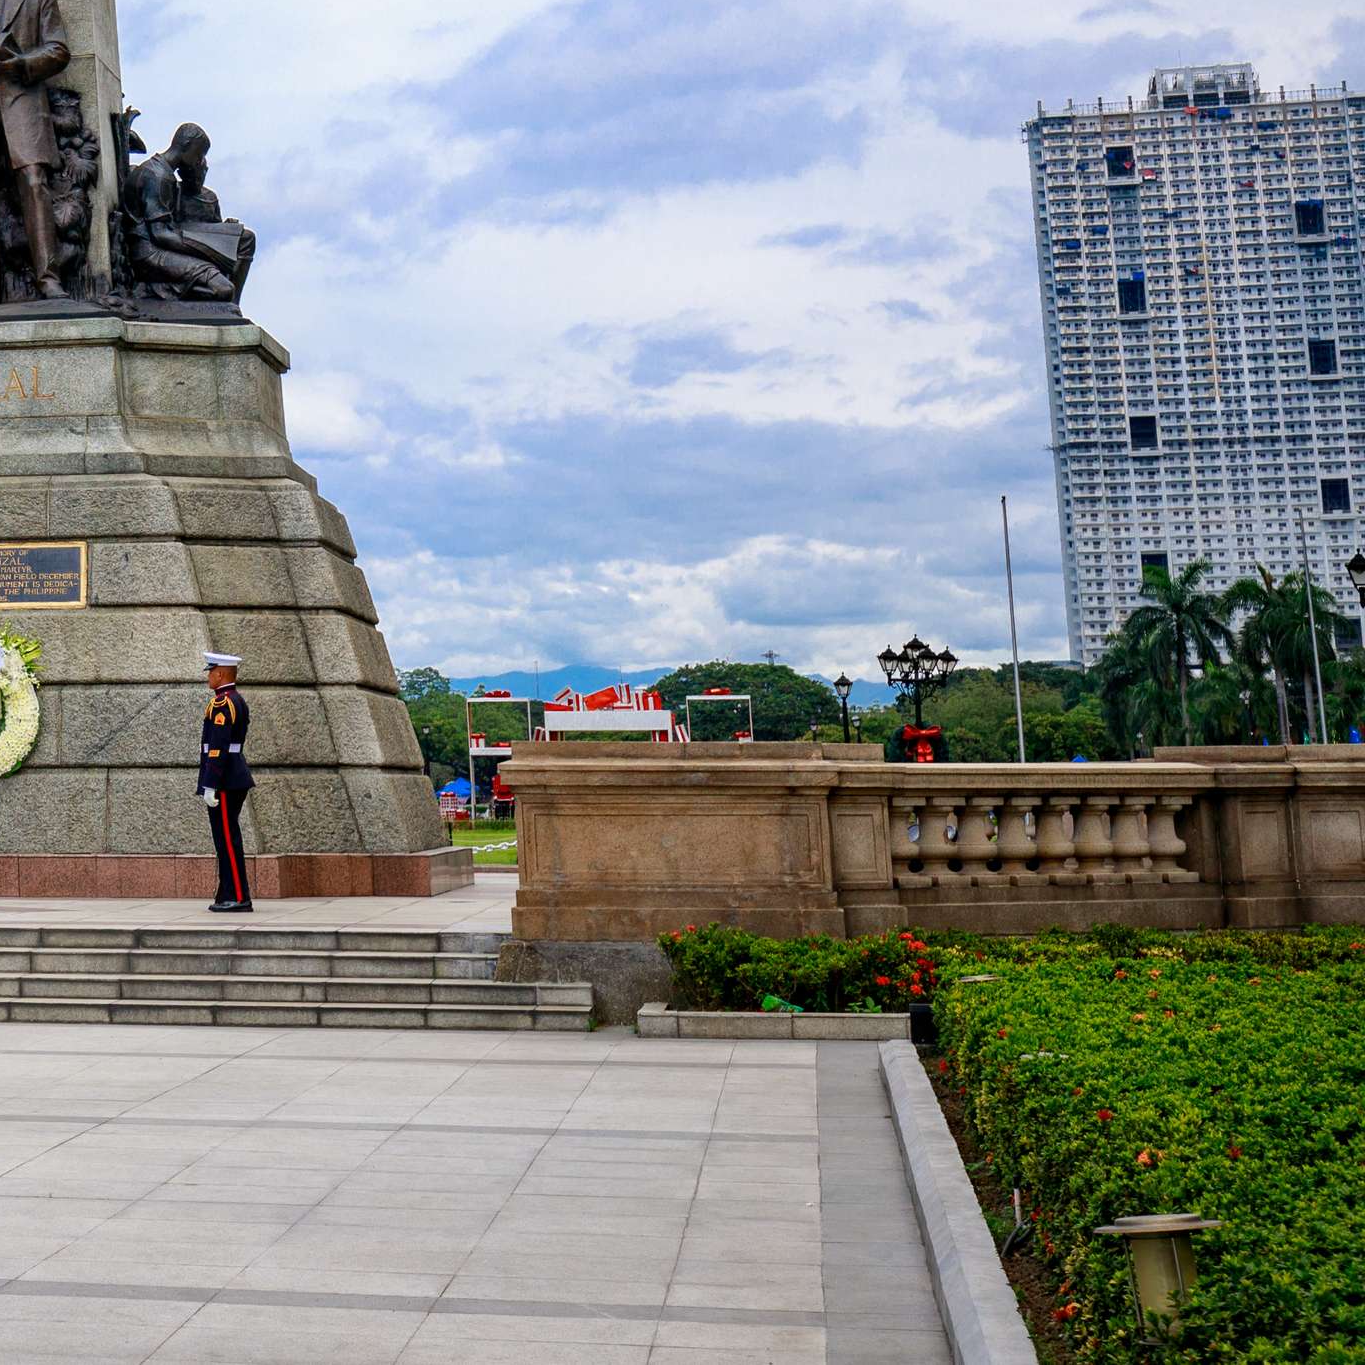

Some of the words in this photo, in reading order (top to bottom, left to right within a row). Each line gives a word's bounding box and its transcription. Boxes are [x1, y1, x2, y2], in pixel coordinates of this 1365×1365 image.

[0, 565, 33, 573] MARTYR
[13, 573, 37, 581] FIELD
[38, 572, 80, 581] DECEMBER
[32, 580, 40, 588] IS
[43, 580, 78, 588] DEDICA-
[4, 588, 20, 596] THE
[23, 587, 68, 595] PHILIPPINE
